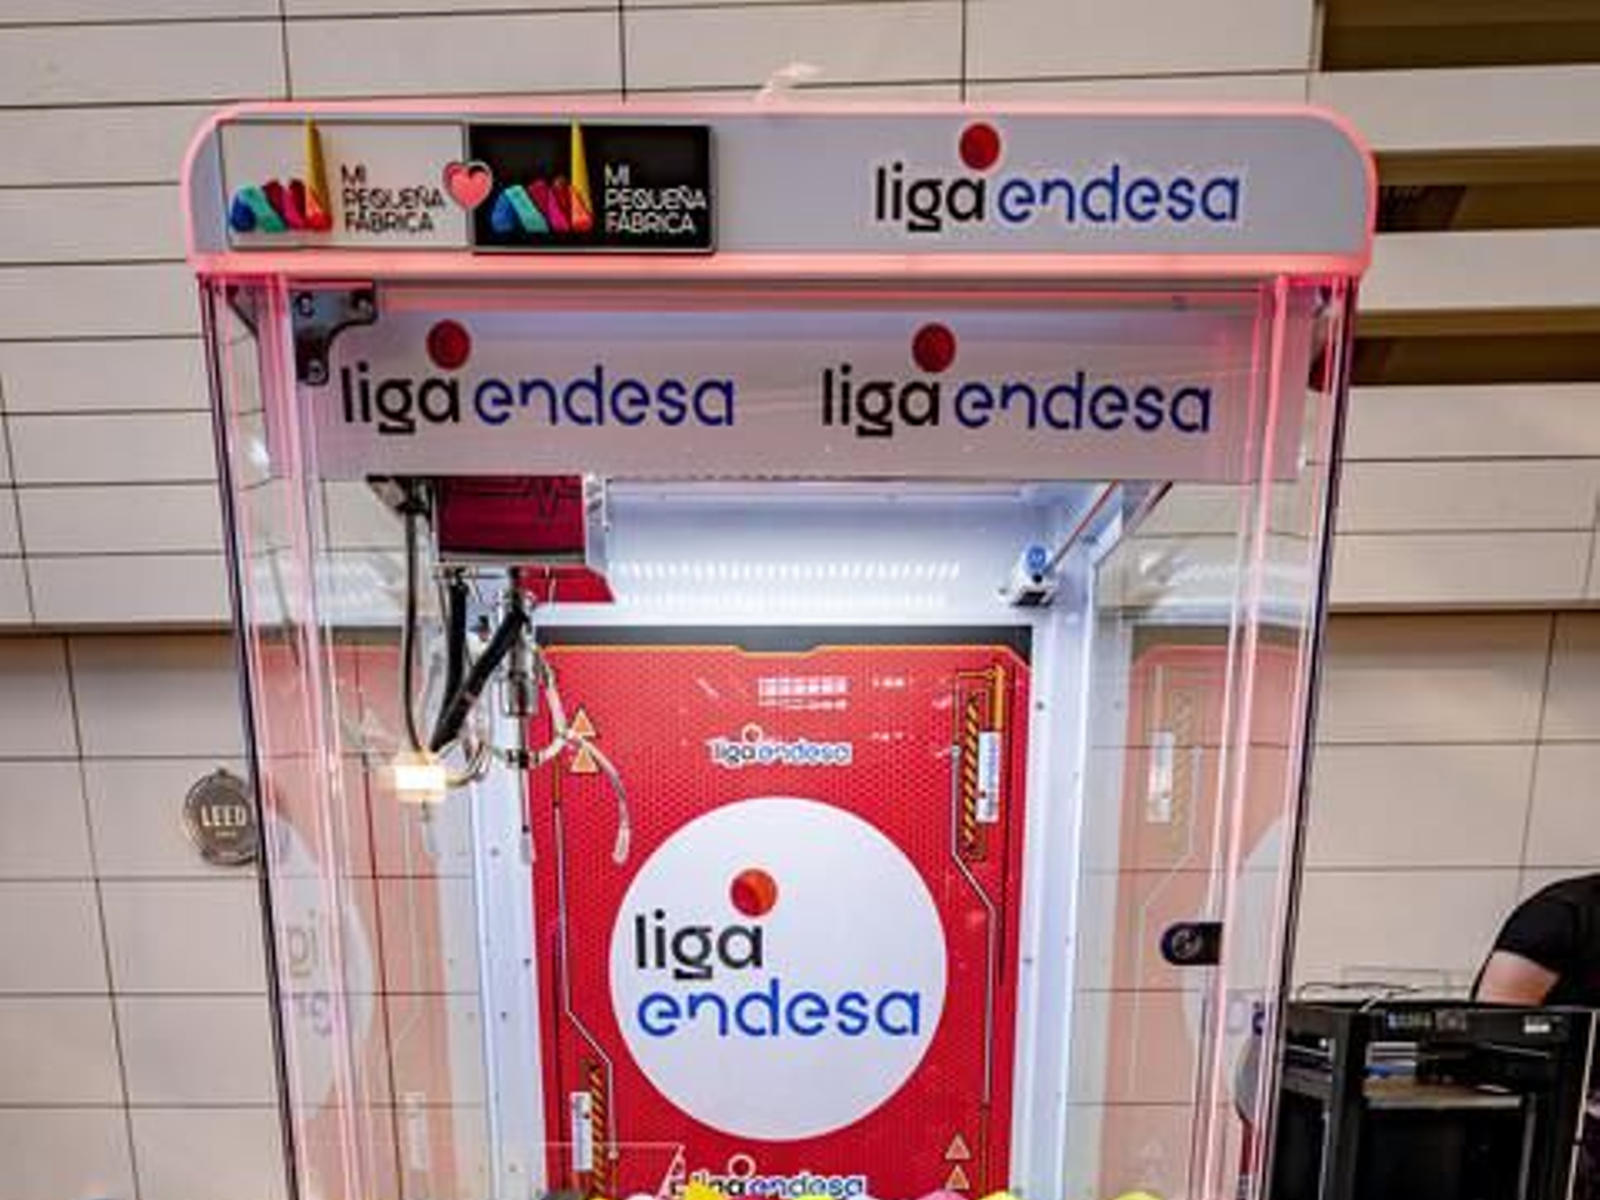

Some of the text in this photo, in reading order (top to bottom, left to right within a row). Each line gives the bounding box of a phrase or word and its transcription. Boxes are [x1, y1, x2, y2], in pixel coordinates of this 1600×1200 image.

[342, 164, 367, 185] MI
[604, 163, 630, 186] MI
[343, 185, 446, 210] PEQUEÑA
[604, 185, 707, 210] PEQUEÑA
[876, 163, 1239, 232] liga endesa
[342, 362, 734, 434] liga endesa
[823, 364, 1210, 437] liga endesa
[635, 909, 763, 979] liga
[637, 978, 921, 1036] endesa
[748, 1173, 863, 1196] endesa
